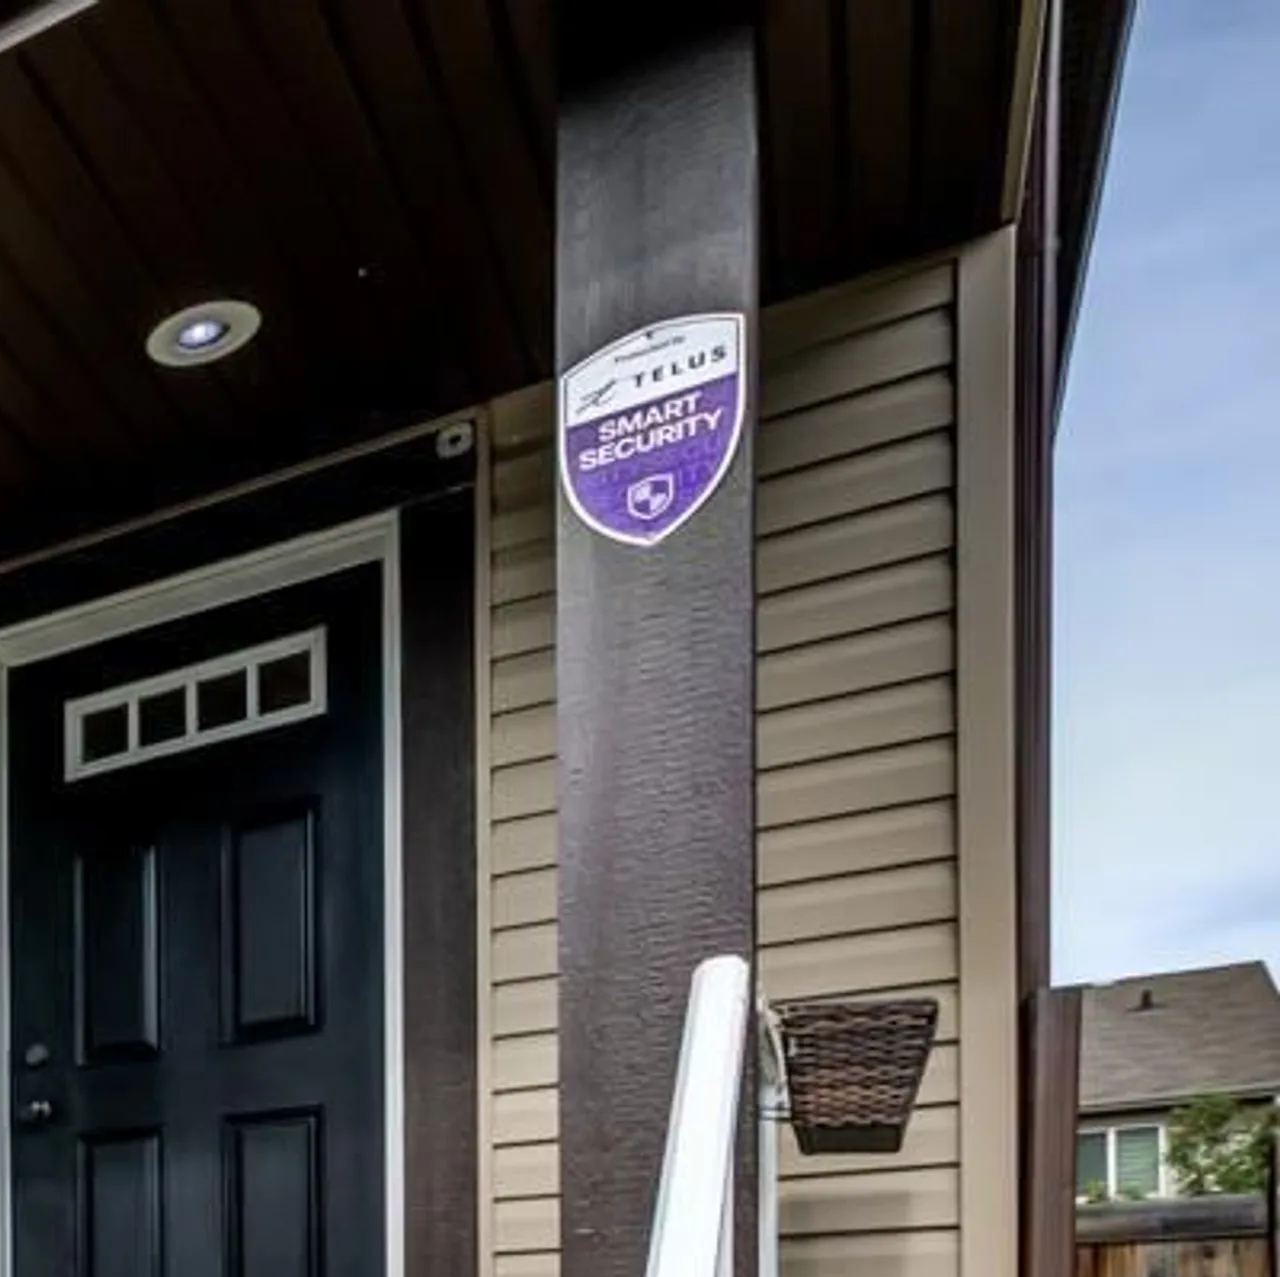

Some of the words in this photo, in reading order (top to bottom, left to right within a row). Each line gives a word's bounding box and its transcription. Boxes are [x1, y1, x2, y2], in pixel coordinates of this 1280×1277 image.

[634, 345, 727, 389] TELUS
[578, 406, 724, 472] SECURITY
[597, 390, 703, 443] SMART
